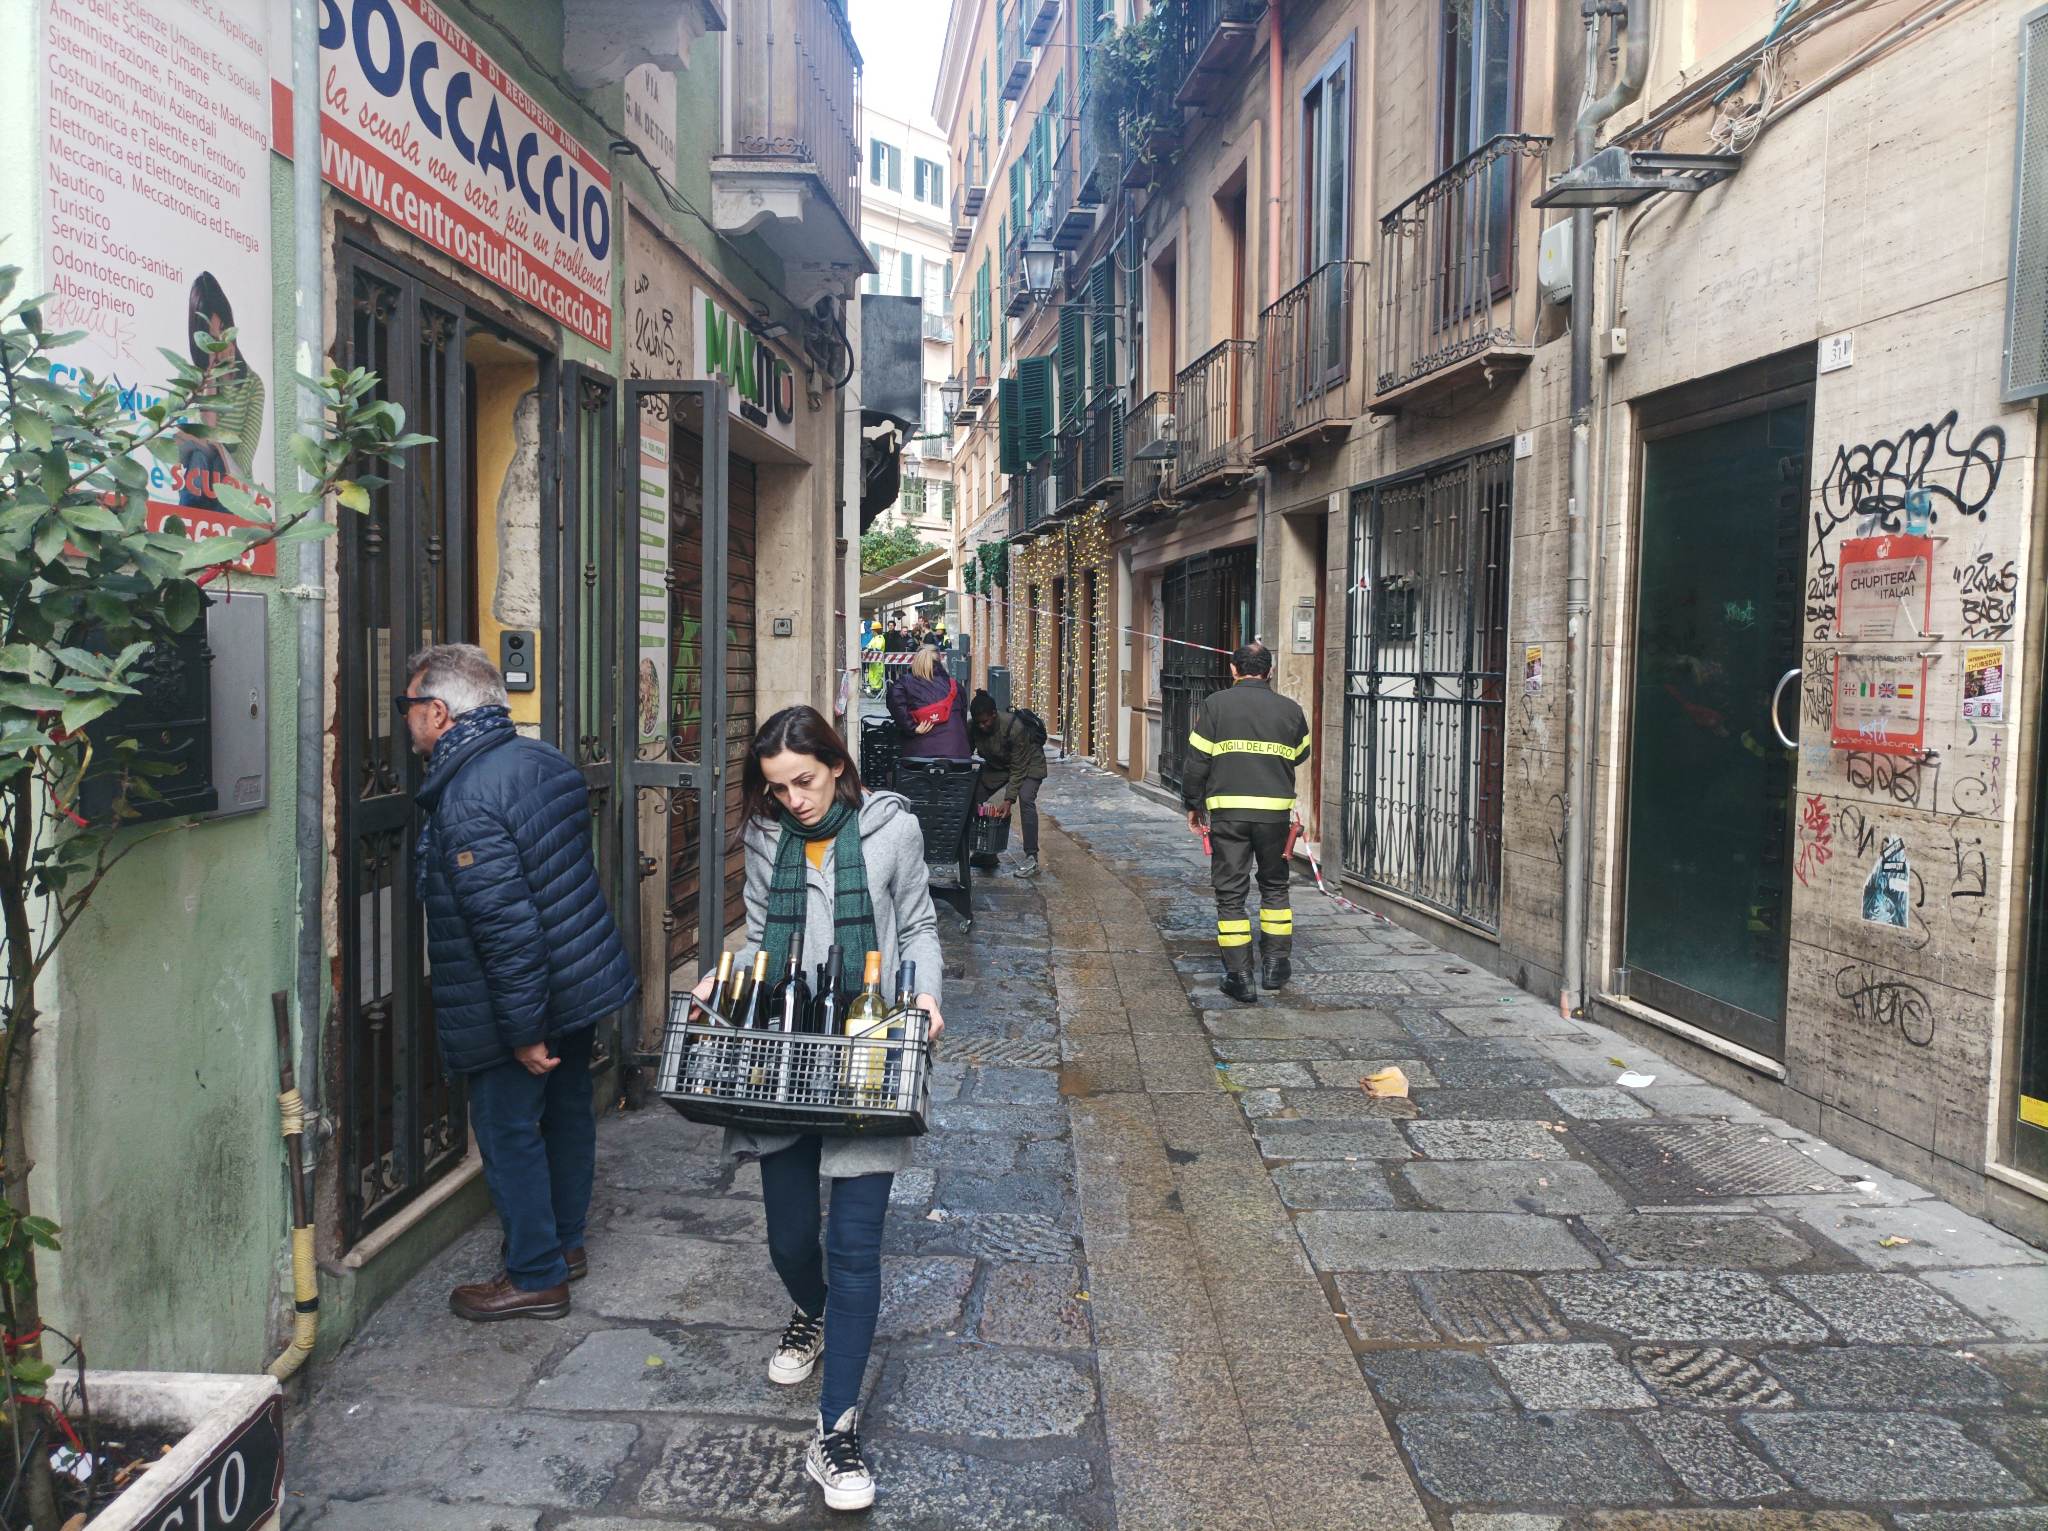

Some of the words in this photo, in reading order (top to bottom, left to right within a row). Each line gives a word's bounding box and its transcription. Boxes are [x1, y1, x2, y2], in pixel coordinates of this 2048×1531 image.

[122, 14, 168, 58] Scienze
[170, 44, 210, 86] Umane
[170, 23, 209, 66] Umane
[227, 64, 261, 101] Sociale
[219, 10, 264, 57] Applicate
[48, 24, 97, 69] Sistemi
[99, 52, 167, 107] Informativi
[169, 96, 218, 139] Aziendali
[49, 0, 162, 84] Amministrazione,
[167, 68, 209, 110] Finanza
[211, 101, 218, 116] e
[219, 103, 268, 152] Marketing
[420, 0, 469, 60] PRIVATA
[475, 50, 484, 69] E
[488, 59, 501, 86] DI
[505, 77, 556, 136] RECUPERO
[558, 131, 581, 160] ANNI
[644, 69, 659, 104] VIA
[48, 53, 129, 115] Costruzioni,
[131, 99, 190, 148] Ambiente
[191, 137, 199, 152] e
[199, 137, 247, 180] Territorio
[50, 79, 128, 137] Informatica
[130, 127, 139, 143] e
[140, 127, 242, 199] Telecomunicazioni
[319, 0, 610, 261] OCCACCIO
[624, 92, 633, 117] G.
[643, 109, 677, 162] DETTORI
[49, 106, 124, 160] Elettronica
[126, 150, 143, 169] ed
[145, 155, 221, 211] Elettrotecnica
[49, 162, 105, 204] Nautico
[49, 133, 126, 189] Meccanica,
[131, 173, 208, 226] Meccatronica
[209, 216, 223, 233] ed
[224, 220, 261, 253] Energia
[324, 63, 350, 117] la
[357, 100, 422, 167] scuola
[427, 153, 459, 190] non
[463, 183, 502, 221] sarà
[503, 204, 529, 241] più
[533, 229, 551, 258] un
[552, 240, 611, 298] problema!
[49, 187, 111, 232] Turistico
[51, 214, 98, 250] Servizi
[101, 234, 184, 285] Socio-sanitari
[52, 245, 154, 299] Odontotecnico
[52, 273, 136, 318] Alberghiero
[1850, 569, 1917, 591] CHUPITERIA
[1967, 658, 2001, 671] THURSDAY
[1219, 741, 1245, 752] VIGILI
[1246, 741, 1264, 752] DEL
[1266, 743, 1293, 758] FUOCO
